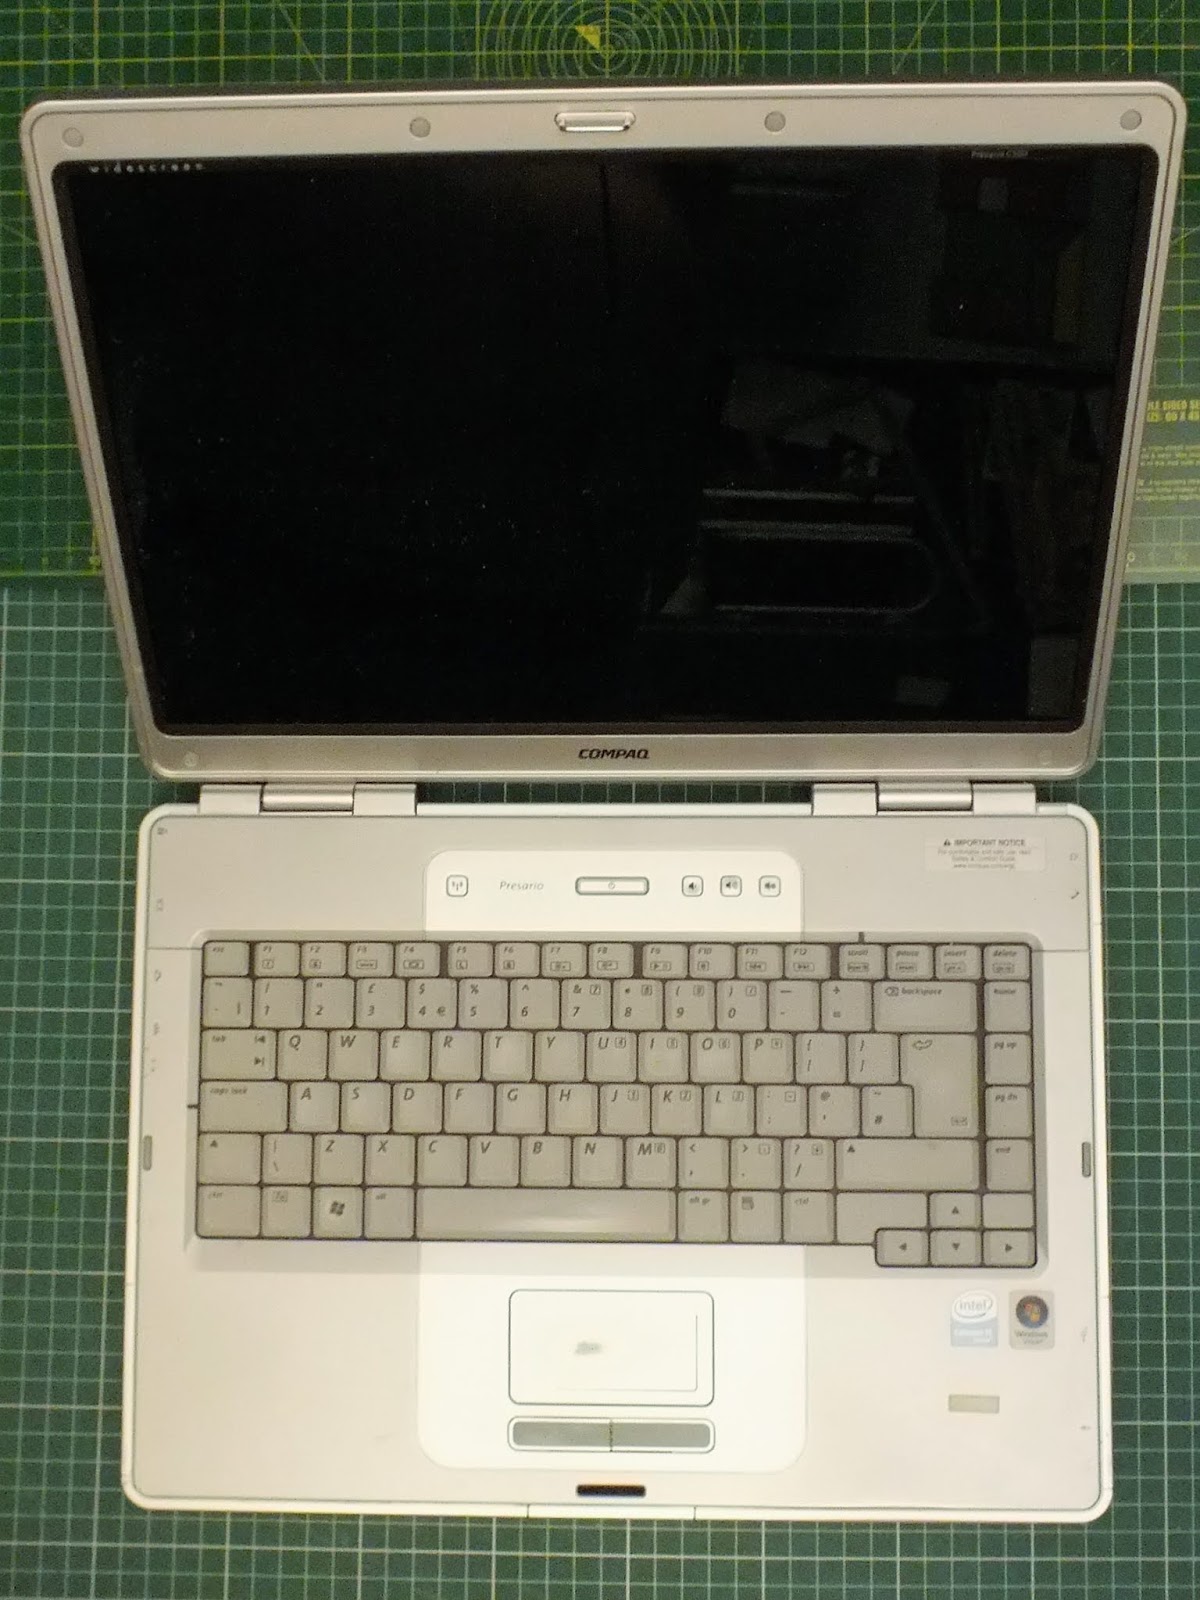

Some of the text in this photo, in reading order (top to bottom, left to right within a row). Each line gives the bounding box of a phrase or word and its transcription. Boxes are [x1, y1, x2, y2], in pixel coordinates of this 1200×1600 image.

[578, 748, 651, 760] COMPAQ
[954, 839, 1025, 847] IMPORTANT NOTICE
[499, 880, 545, 891] Presario
[902, 988, 942, 996] backspace
[265, 1005, 270, 1015] 1
[316, 1005, 323, 1015] 2
[368, 1005, 375, 1016] 3
[419, 1006, 426, 1016] 4
[470, 1006, 477, 1017] 5
[522, 1006, 528, 1016] 6
[573, 1007, 580, 1016] 7
[625, 1007, 632, 1017] 8
[677, 1007, 684, 1018] 9
[728, 1008, 736, 1018] 0
[289, 1035, 301, 1051] Q
[341, 1035, 356, 1048] W
[392, 1036, 400, 1048] E
[444, 1036, 453, 1048] R
[496, 1036, 503, 1048] T
[547, 1036, 556, 1048] Y
[598, 1037, 609, 1050] U
[702, 1038, 713, 1050] O
[754, 1038, 763, 1050] P
[301, 1087, 311, 1100] A
[352, 1087, 359, 1099] S
[404, 1088, 414, 1100] D
[456, 1088, 463, 1100] F
[507, 1088, 518, 1102] G
[560, 1089, 571, 1101] H
[611, 1090, 618, 1102] J
[664, 1091, 672, 1102] K
[716, 1091, 721, 1103] L
[325, 1140, 335, 1152] Z
[378, 1140, 388, 1152] X
[429, 1140, 437, 1153] C
[481, 1141, 491, 1153] V
[533, 1142, 542, 1154] B
[585, 1143, 596, 1155] N
[638, 1143, 651, 1155] M
